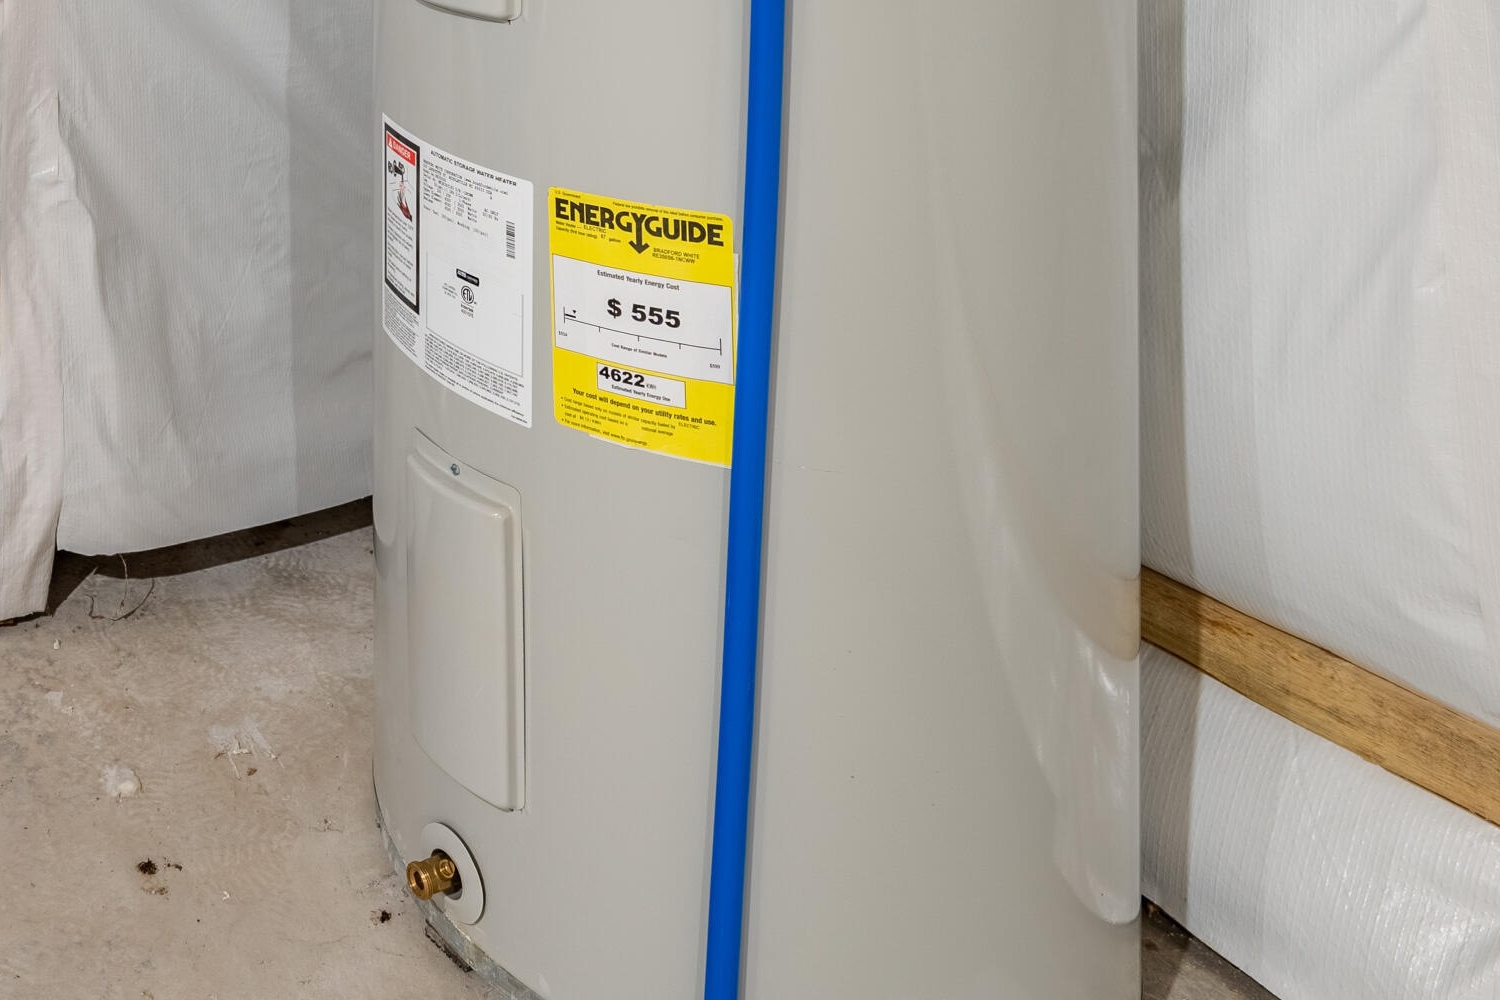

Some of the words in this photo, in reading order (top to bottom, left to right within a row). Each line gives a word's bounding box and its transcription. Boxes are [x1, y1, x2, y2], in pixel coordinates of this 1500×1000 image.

[476, 169, 494, 179] WATER
[495, 176, 517, 187] HEATER
[555, 197, 724, 250] ENERGYGUIDE
[597, 269, 624, 282] Estimated
[626, 272, 643, 285] Yearly
[644, 278, 664, 289] Energy
[666, 282, 680, 291] Cost
[606, 298, 622, 318] $
[631, 303, 681, 329] 555
[599, 366, 645, 388] 4622
[572, 388, 585, 397] Your
[585, 391, 598, 401] cost
[599, 395, 609, 404] will
[609, 398, 631, 410] depend
[641, 406, 654, 416] your
[655, 408, 673, 419] utility
[674, 413, 689, 422] rates
[690, 416, 703, 424] and
[704, 418, 717, 426] use.
